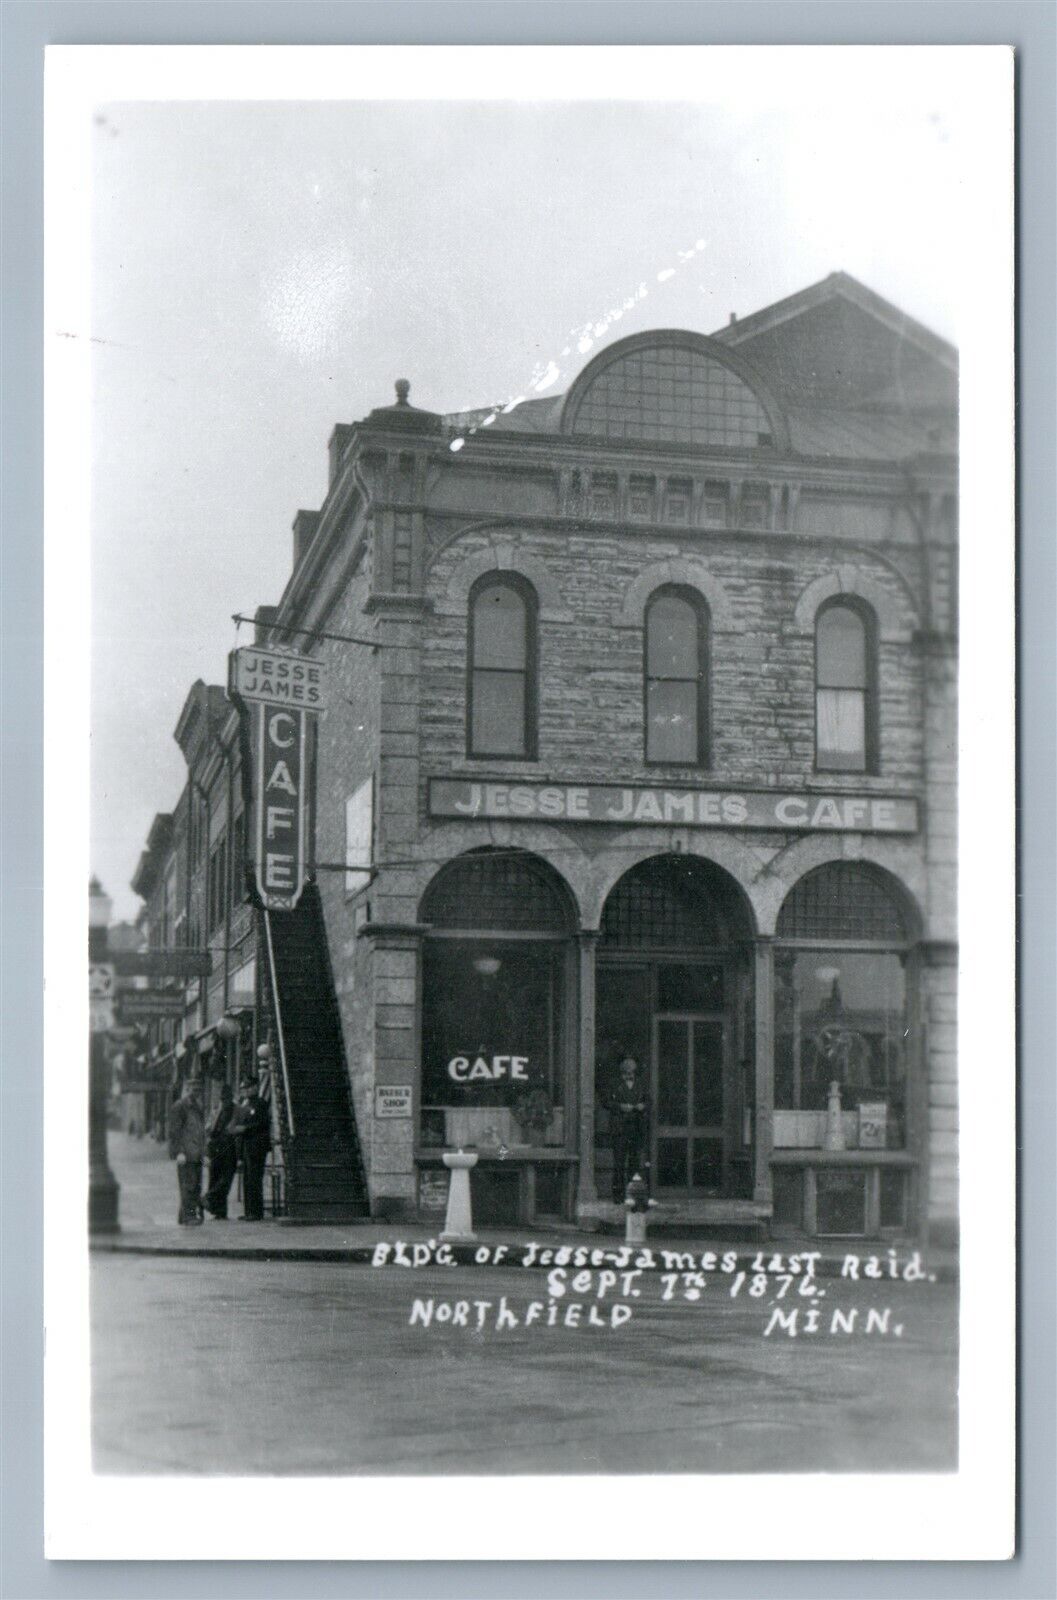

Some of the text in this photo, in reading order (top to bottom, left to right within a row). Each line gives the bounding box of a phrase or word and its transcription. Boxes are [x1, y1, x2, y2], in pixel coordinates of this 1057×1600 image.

[245, 658, 320, 684] JESSE
[244, 677, 320, 703] JAMES
[265, 712, 297, 889] CAFE
[454, 783, 896, 830] JESSE JAMES CAFE
[448, 1055, 529, 1081] CAFE
[383, 1098, 407, 1108] SHOP
